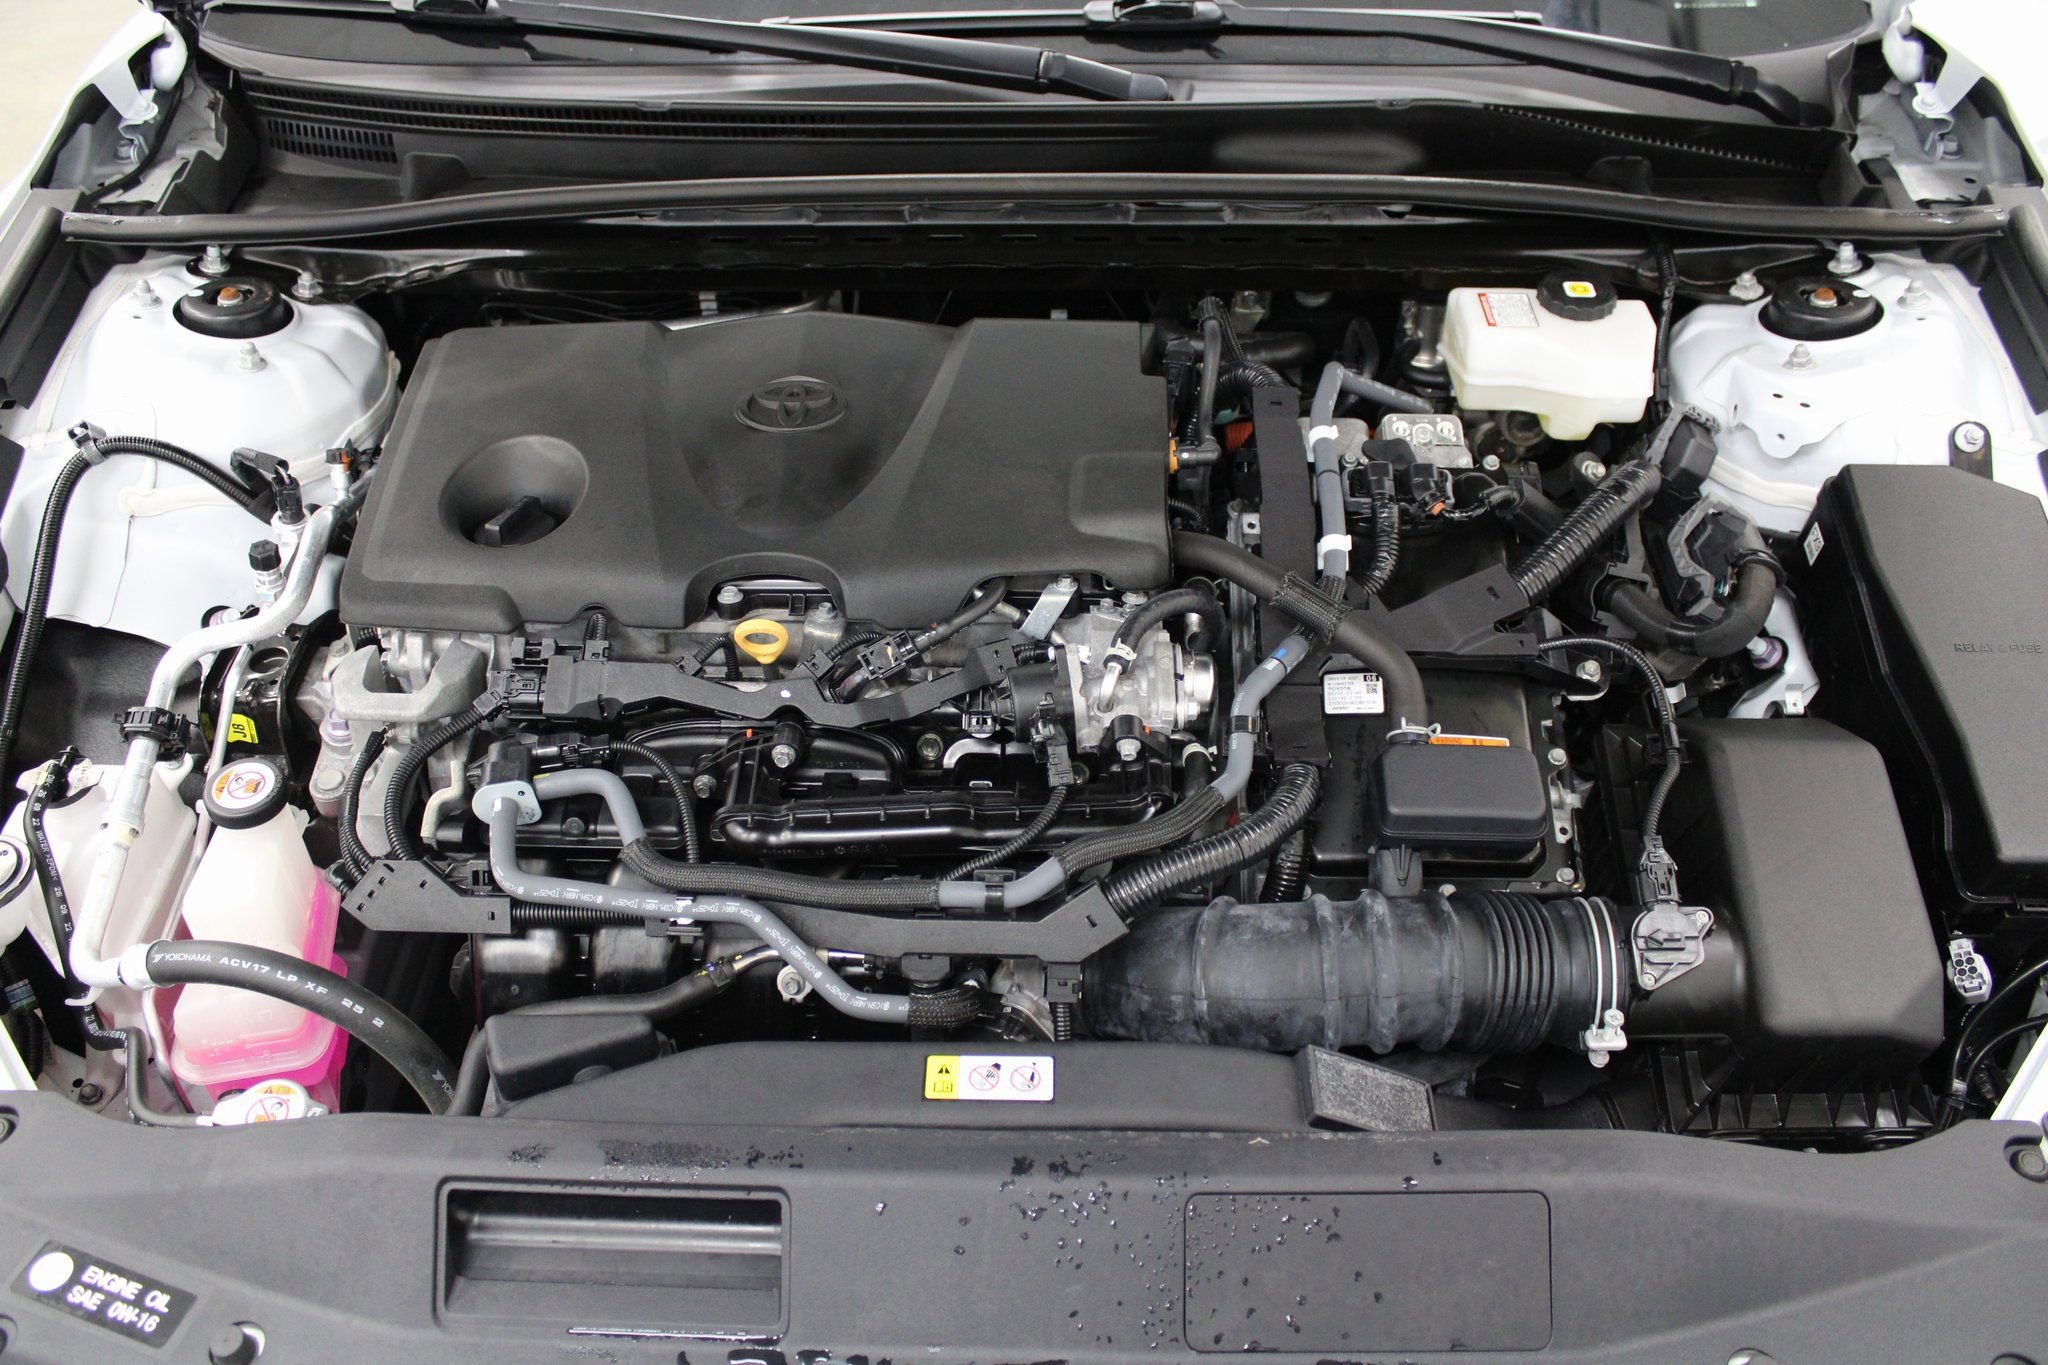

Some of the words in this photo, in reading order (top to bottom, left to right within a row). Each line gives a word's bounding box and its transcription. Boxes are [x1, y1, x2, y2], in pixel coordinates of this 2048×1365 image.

[164, 953, 212, 963] YOKOHAMA
[219, 957, 270, 973] ACV17
[275, 970, 298, 982] LP
[304, 981, 328, 995] XF
[341, 998, 364, 1014] 25
[372, 1017, 385, 1028] 2
[66, 1285, 105, 1311] SAE
[107, 1301, 160, 1333] 0W-16
[81, 1265, 143, 1300] ENGINE
[145, 1290, 172, 1313] OIL
